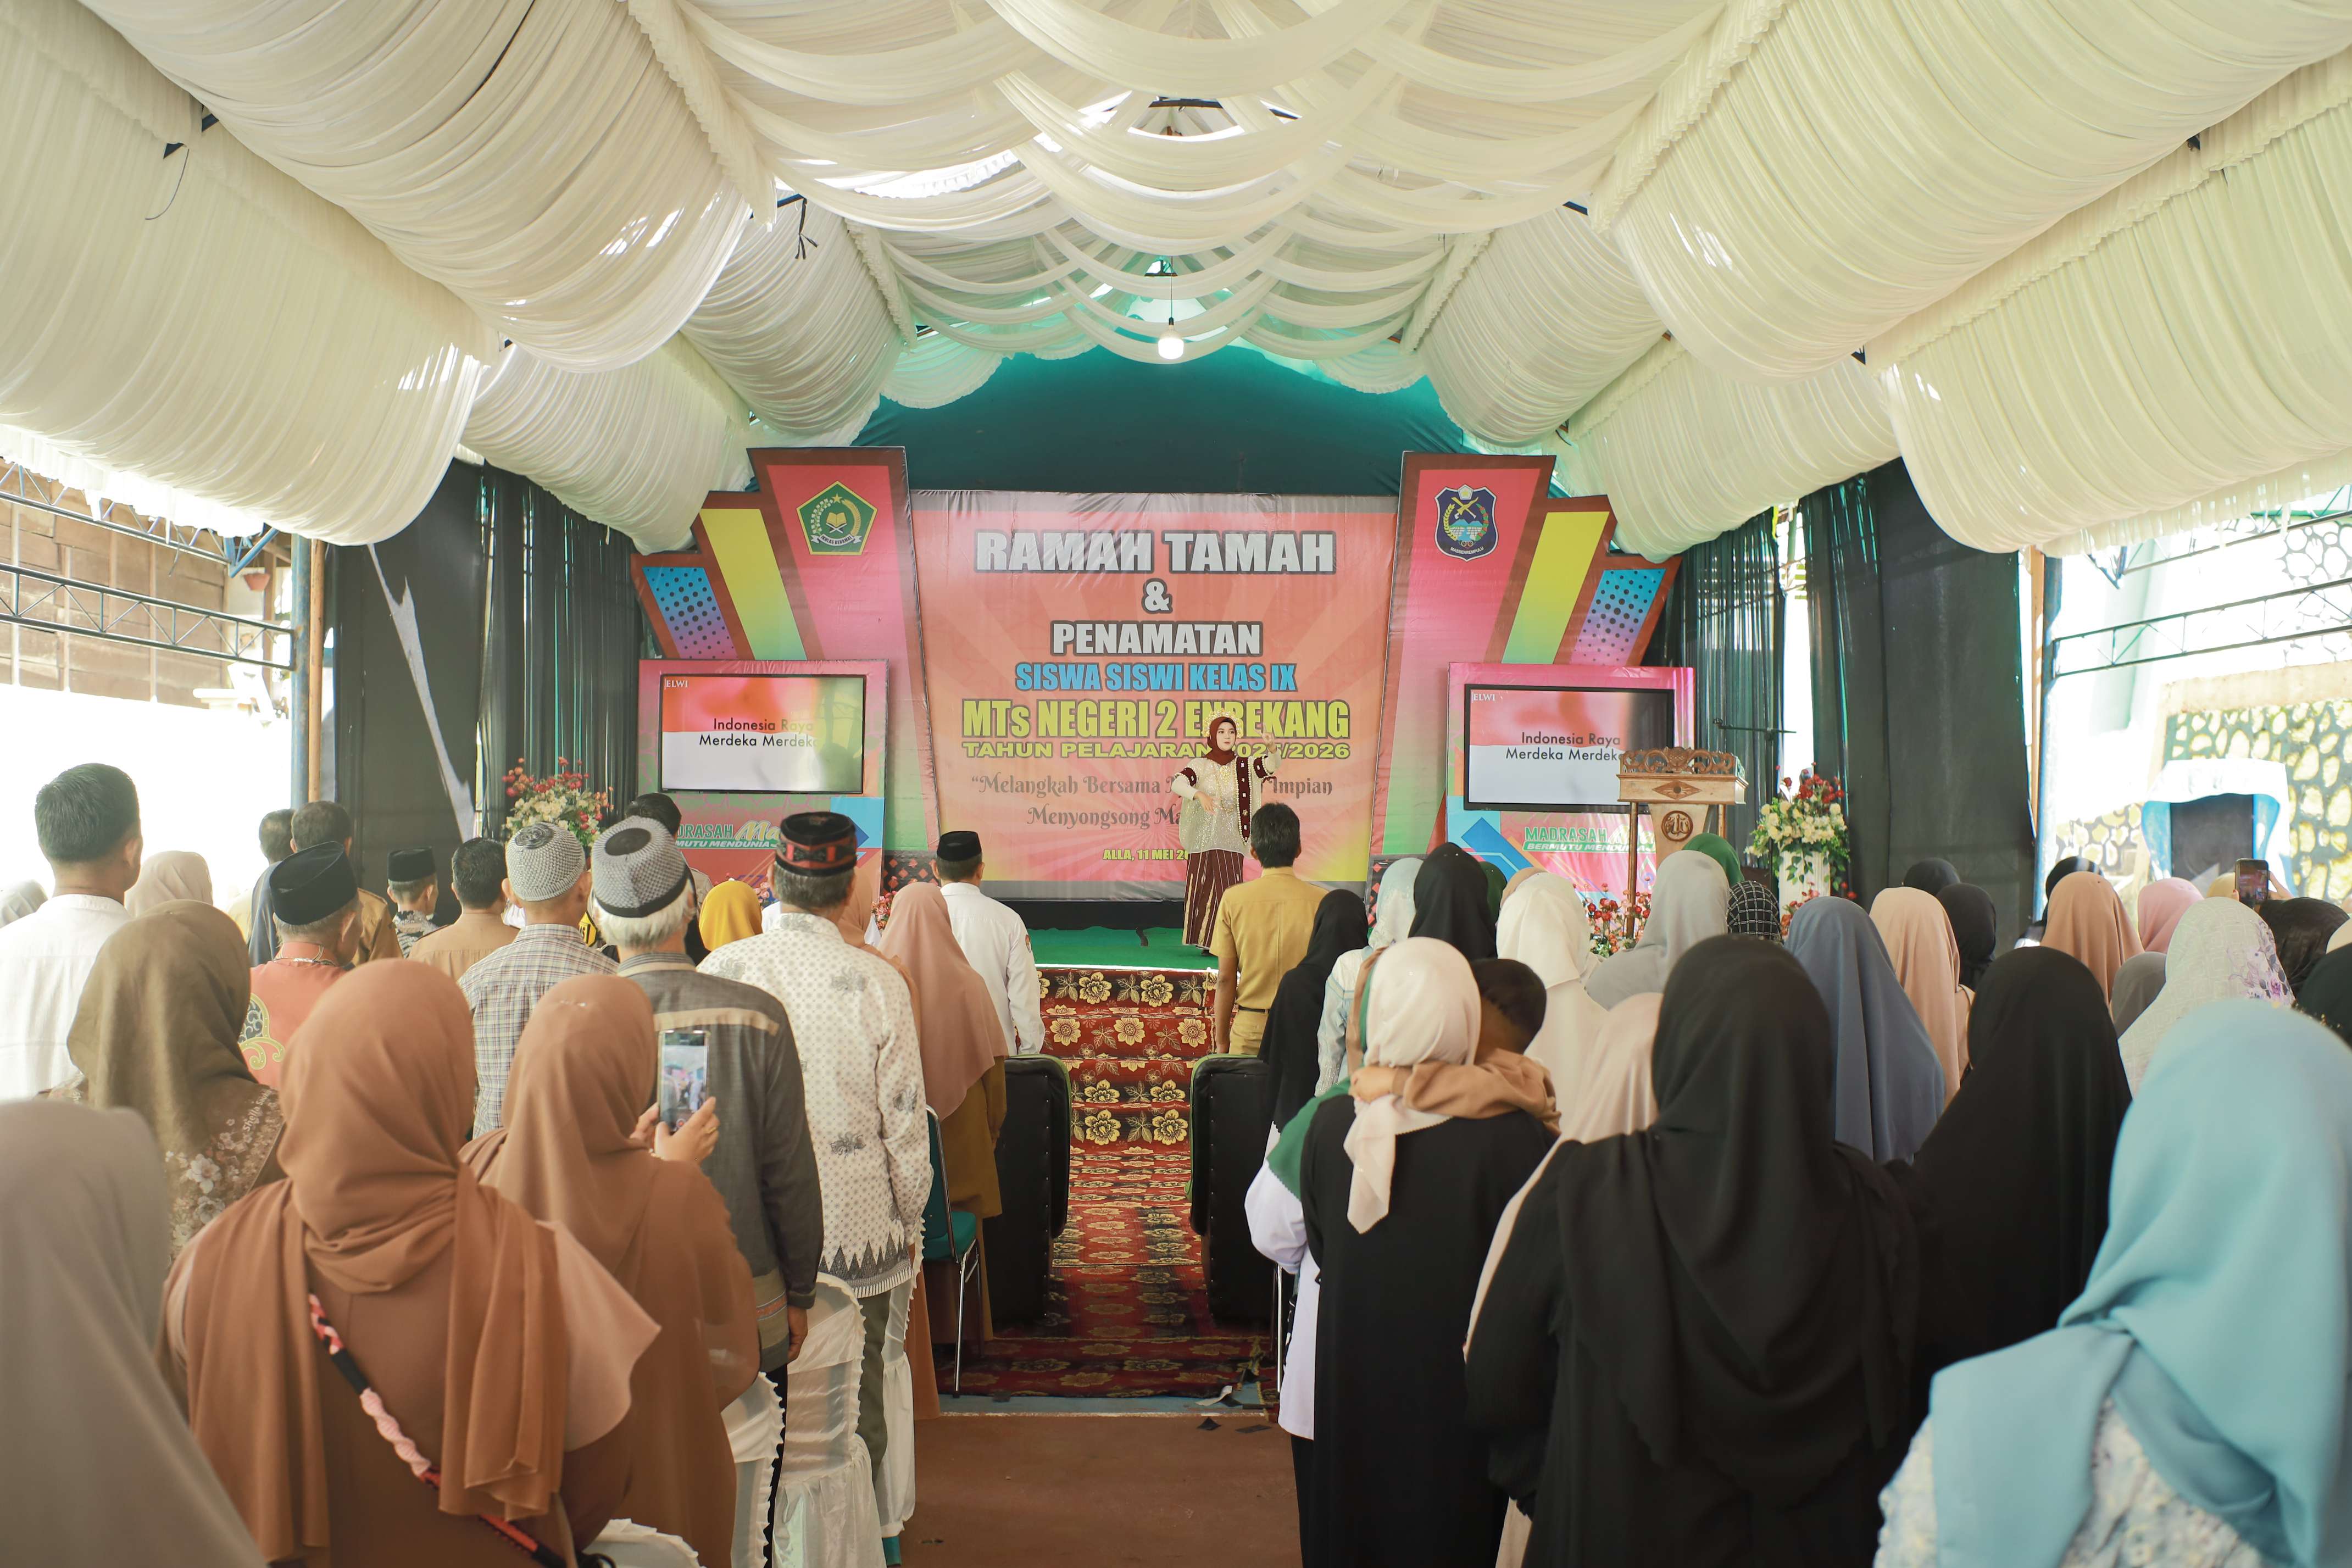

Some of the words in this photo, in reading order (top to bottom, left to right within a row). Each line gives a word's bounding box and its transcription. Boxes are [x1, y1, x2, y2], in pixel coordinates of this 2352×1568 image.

[975, 531, 1153, 572] RAMAH
[1163, 531, 1335, 573] TAMAH
[1142, 579, 1172, 613] &
[1052, 622, 1262, 655] PENAMATAN
[1015, 662, 1102, 691] SISWA
[1105, 662, 1184, 691] SISWI
[1188, 663, 1266, 691] KELAS
[1270, 664, 1297, 691] IX
[714, 718, 776, 731] Indonesia
[781, 719, 814, 734] Raya
[963, 699, 1031, 738] MTs
[1037, 699, 1149, 738] NEGERI
[1155, 699, 1177, 738] 2
[699, 733, 757, 746] Merdeka
[1521, 731, 1584, 745] Indonesia
[1589, 733, 1620, 748] Raya
[962, 742, 1053, 758] TAHUN
[1060, 742, 1213, 758] PELAJARAN
[1505, 747, 1564, 760] Merdeka
[1083, 776, 1160, 793] Bersama
[1270, 777, 1332, 799] Impian
[1027, 804, 1150, 830] Menyongsong
[677, 824, 734, 838] DRASAH
[1525, 826, 1608, 842] MADRASAH
[1103, 849, 1135, 861] ALLA,
[1137, 849, 1149, 860] 11
[1152, 849, 1174, 860] MEI
